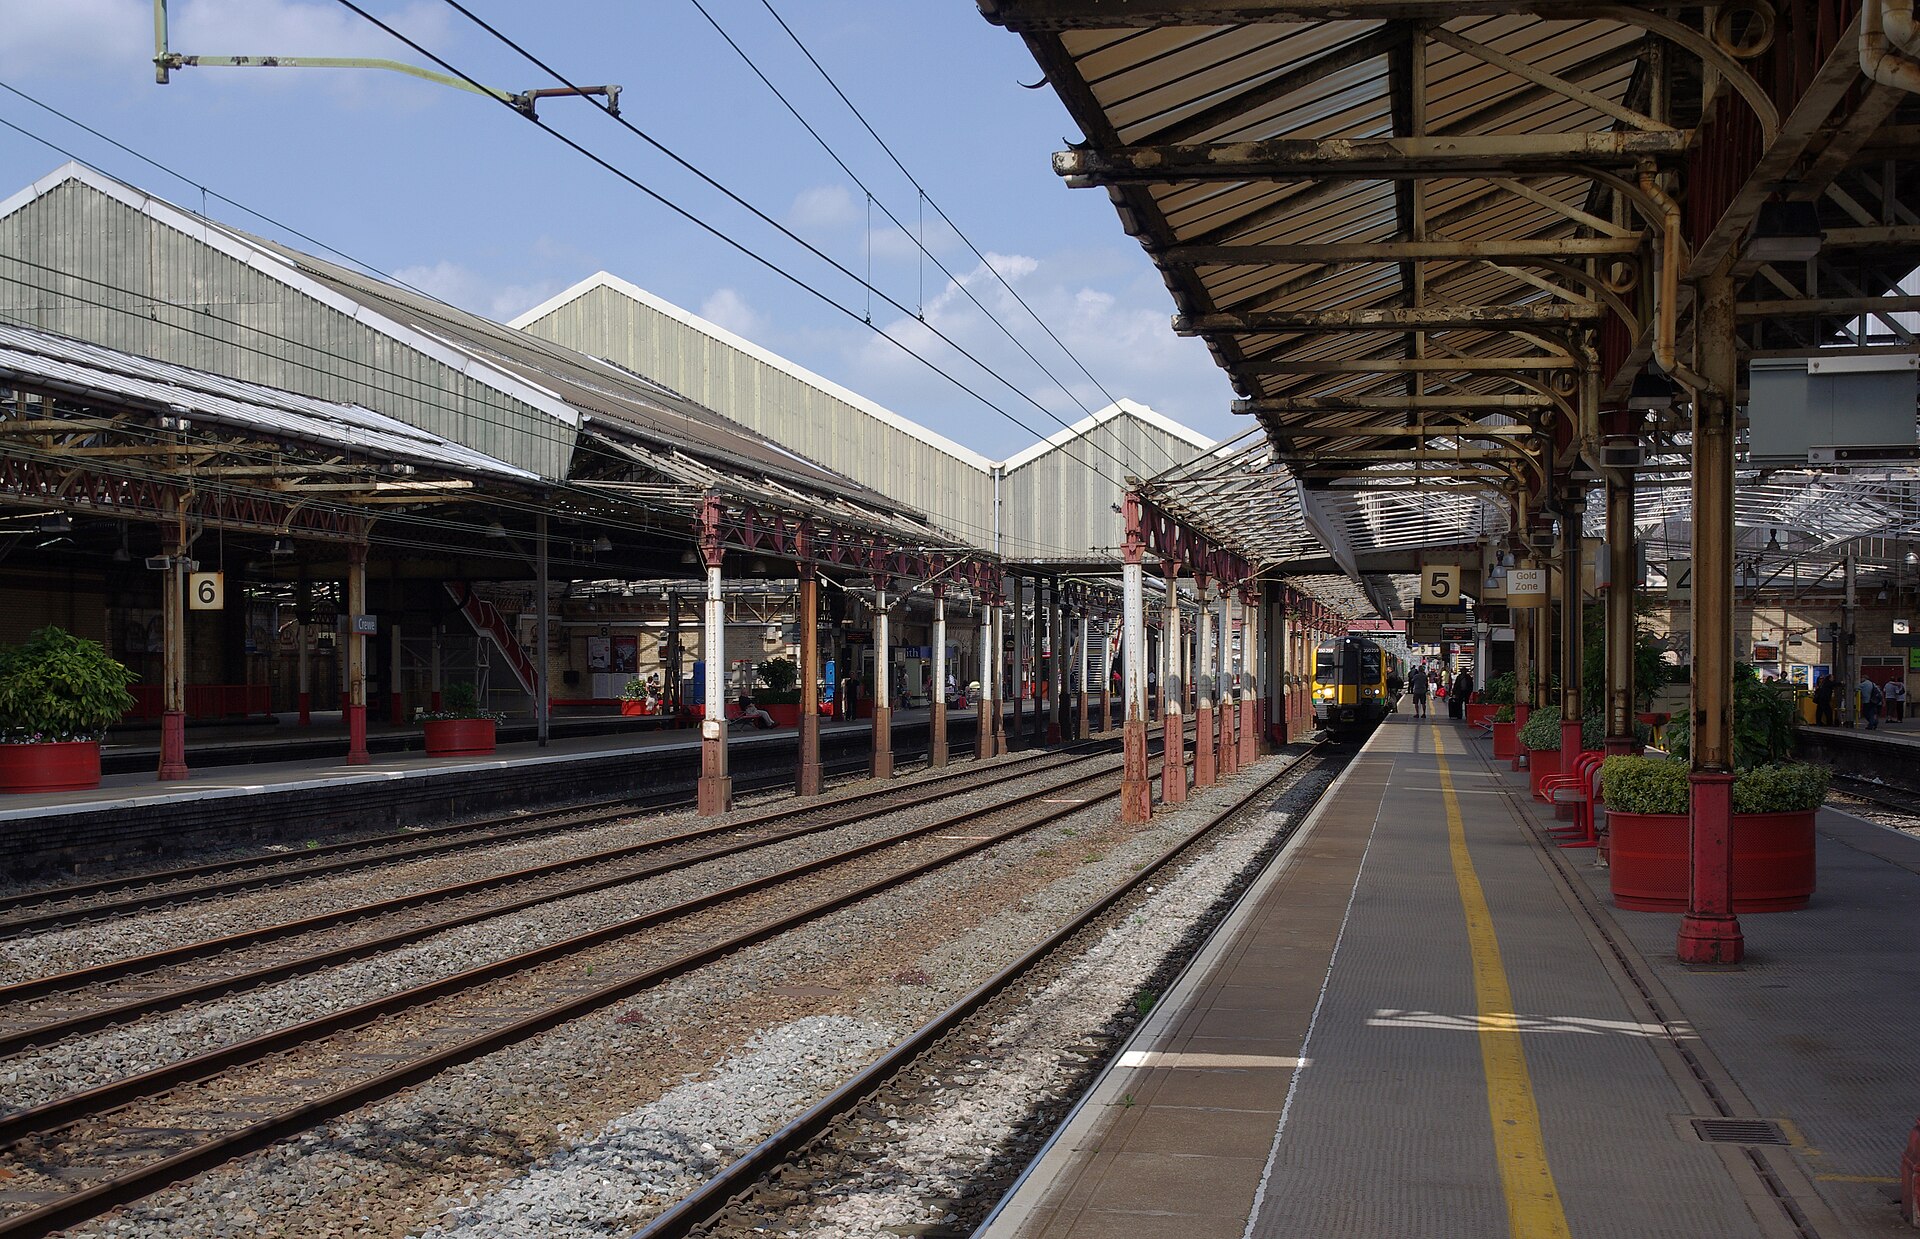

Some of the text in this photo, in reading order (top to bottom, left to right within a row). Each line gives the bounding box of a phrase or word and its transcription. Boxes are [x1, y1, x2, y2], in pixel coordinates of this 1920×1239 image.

[1516, 571, 1537, 580] Gold
[1431, 572, 1450, 598] 5
[1515, 582, 1538, 591] Zone
[198, 580, 215, 604] 6
[358, 618, 375, 631] Crewe
[1897, 622, 1905, 632] 3
[601, 627, 608, 637] 8
[906, 647, 919, 658] ith
